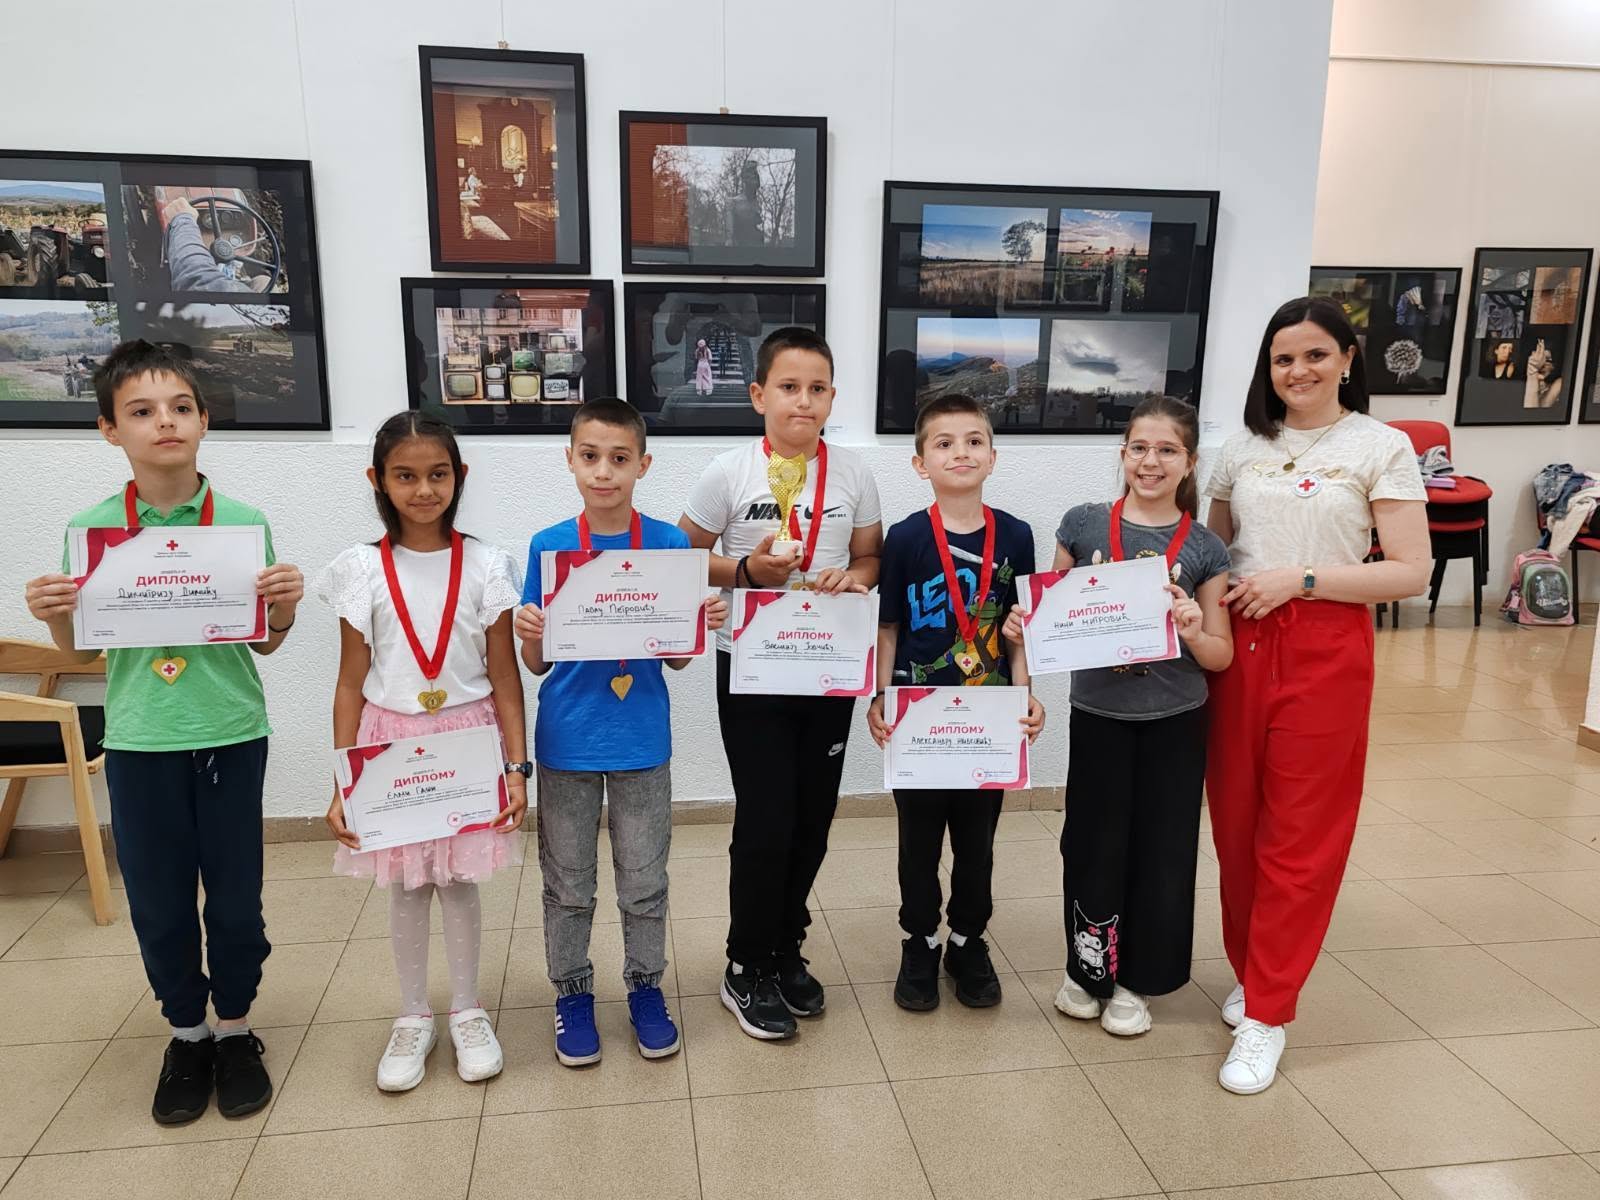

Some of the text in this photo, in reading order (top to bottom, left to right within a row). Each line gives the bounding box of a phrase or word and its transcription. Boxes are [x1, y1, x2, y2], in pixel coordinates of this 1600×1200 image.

[136, 575, 211, 587] ДИПЛОМУ
[595, 592, 659, 603] ДИПЛОМУ
[907, 568, 977, 632] LEO
[1068, 603, 1126, 619] ДИПЛОМУ
[777, 631, 834, 640] ДИПЛОМУ
[930, 726, 985, 735] ДИПЛОМУ
[393, 770, 456, 789] ДИПЛОМУ
